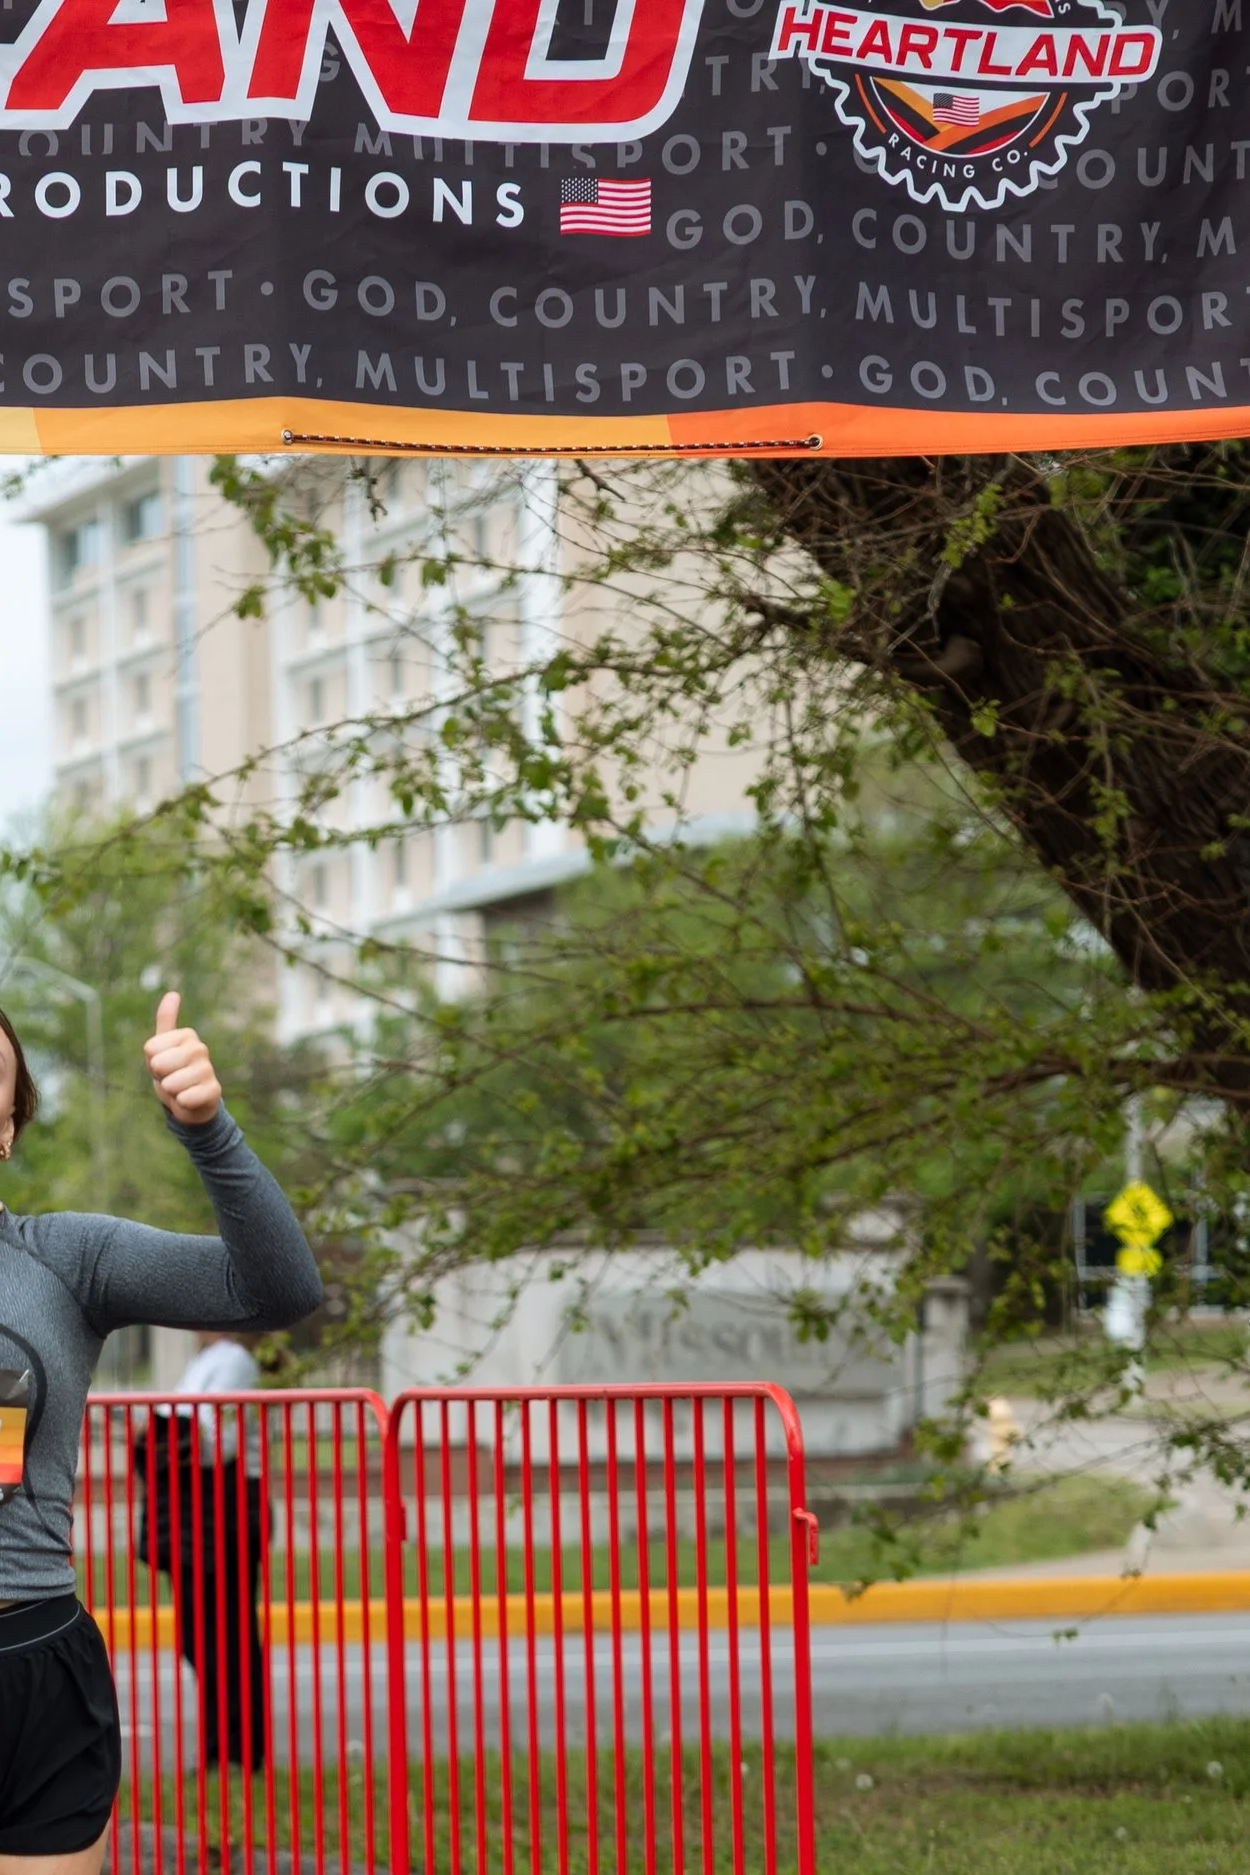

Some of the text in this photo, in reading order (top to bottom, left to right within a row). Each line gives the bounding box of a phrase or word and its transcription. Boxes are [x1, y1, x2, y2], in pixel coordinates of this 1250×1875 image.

[777, 7, 1156, 77] HEARTLAND
[888, 132, 1028, 179] RACING CO.
[666, 200, 824, 251] GOD,
[850, 209, 1168, 264] COUNTRY,
[303, 270, 456, 326] GOD,
[488, 275, 826, 330] COUNTRY,
[855, 282, 1250, 340] MULTISPOR
[355, 350, 795, 403] MULTISPORT
